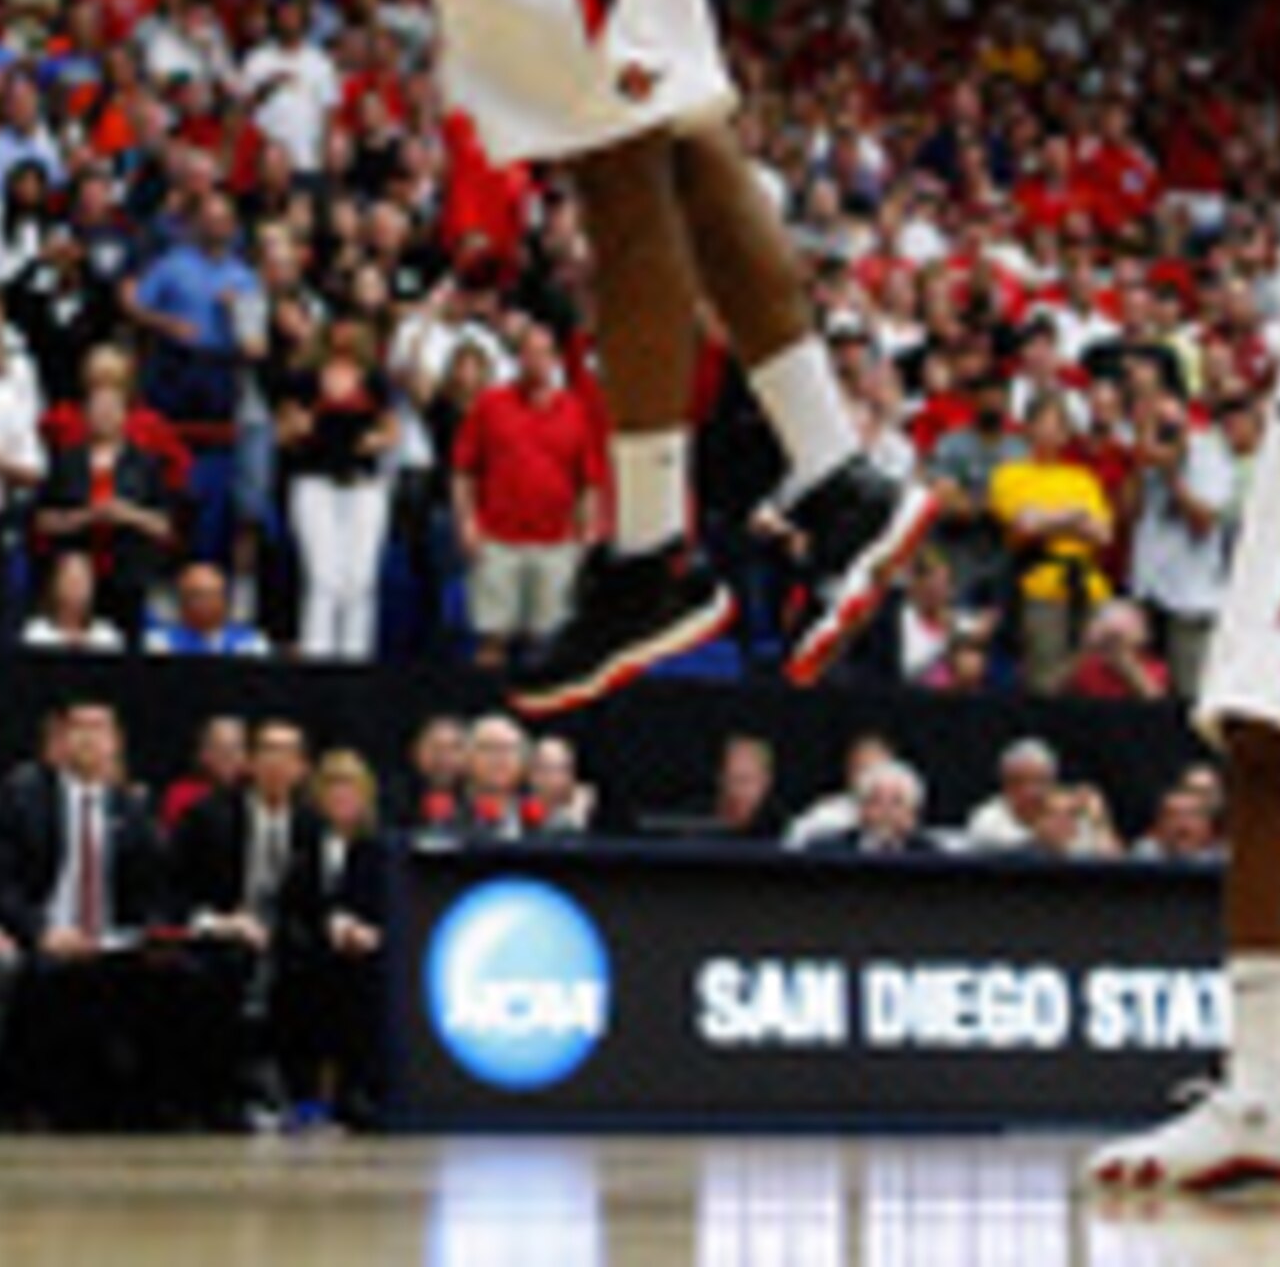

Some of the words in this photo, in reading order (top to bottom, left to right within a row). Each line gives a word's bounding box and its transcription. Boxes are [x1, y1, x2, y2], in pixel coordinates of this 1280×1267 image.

[697, 959, 846, 1043] SAN
[860, 961, 1069, 1047] DIEGO
[1084, 965, 1234, 1050] STAT
